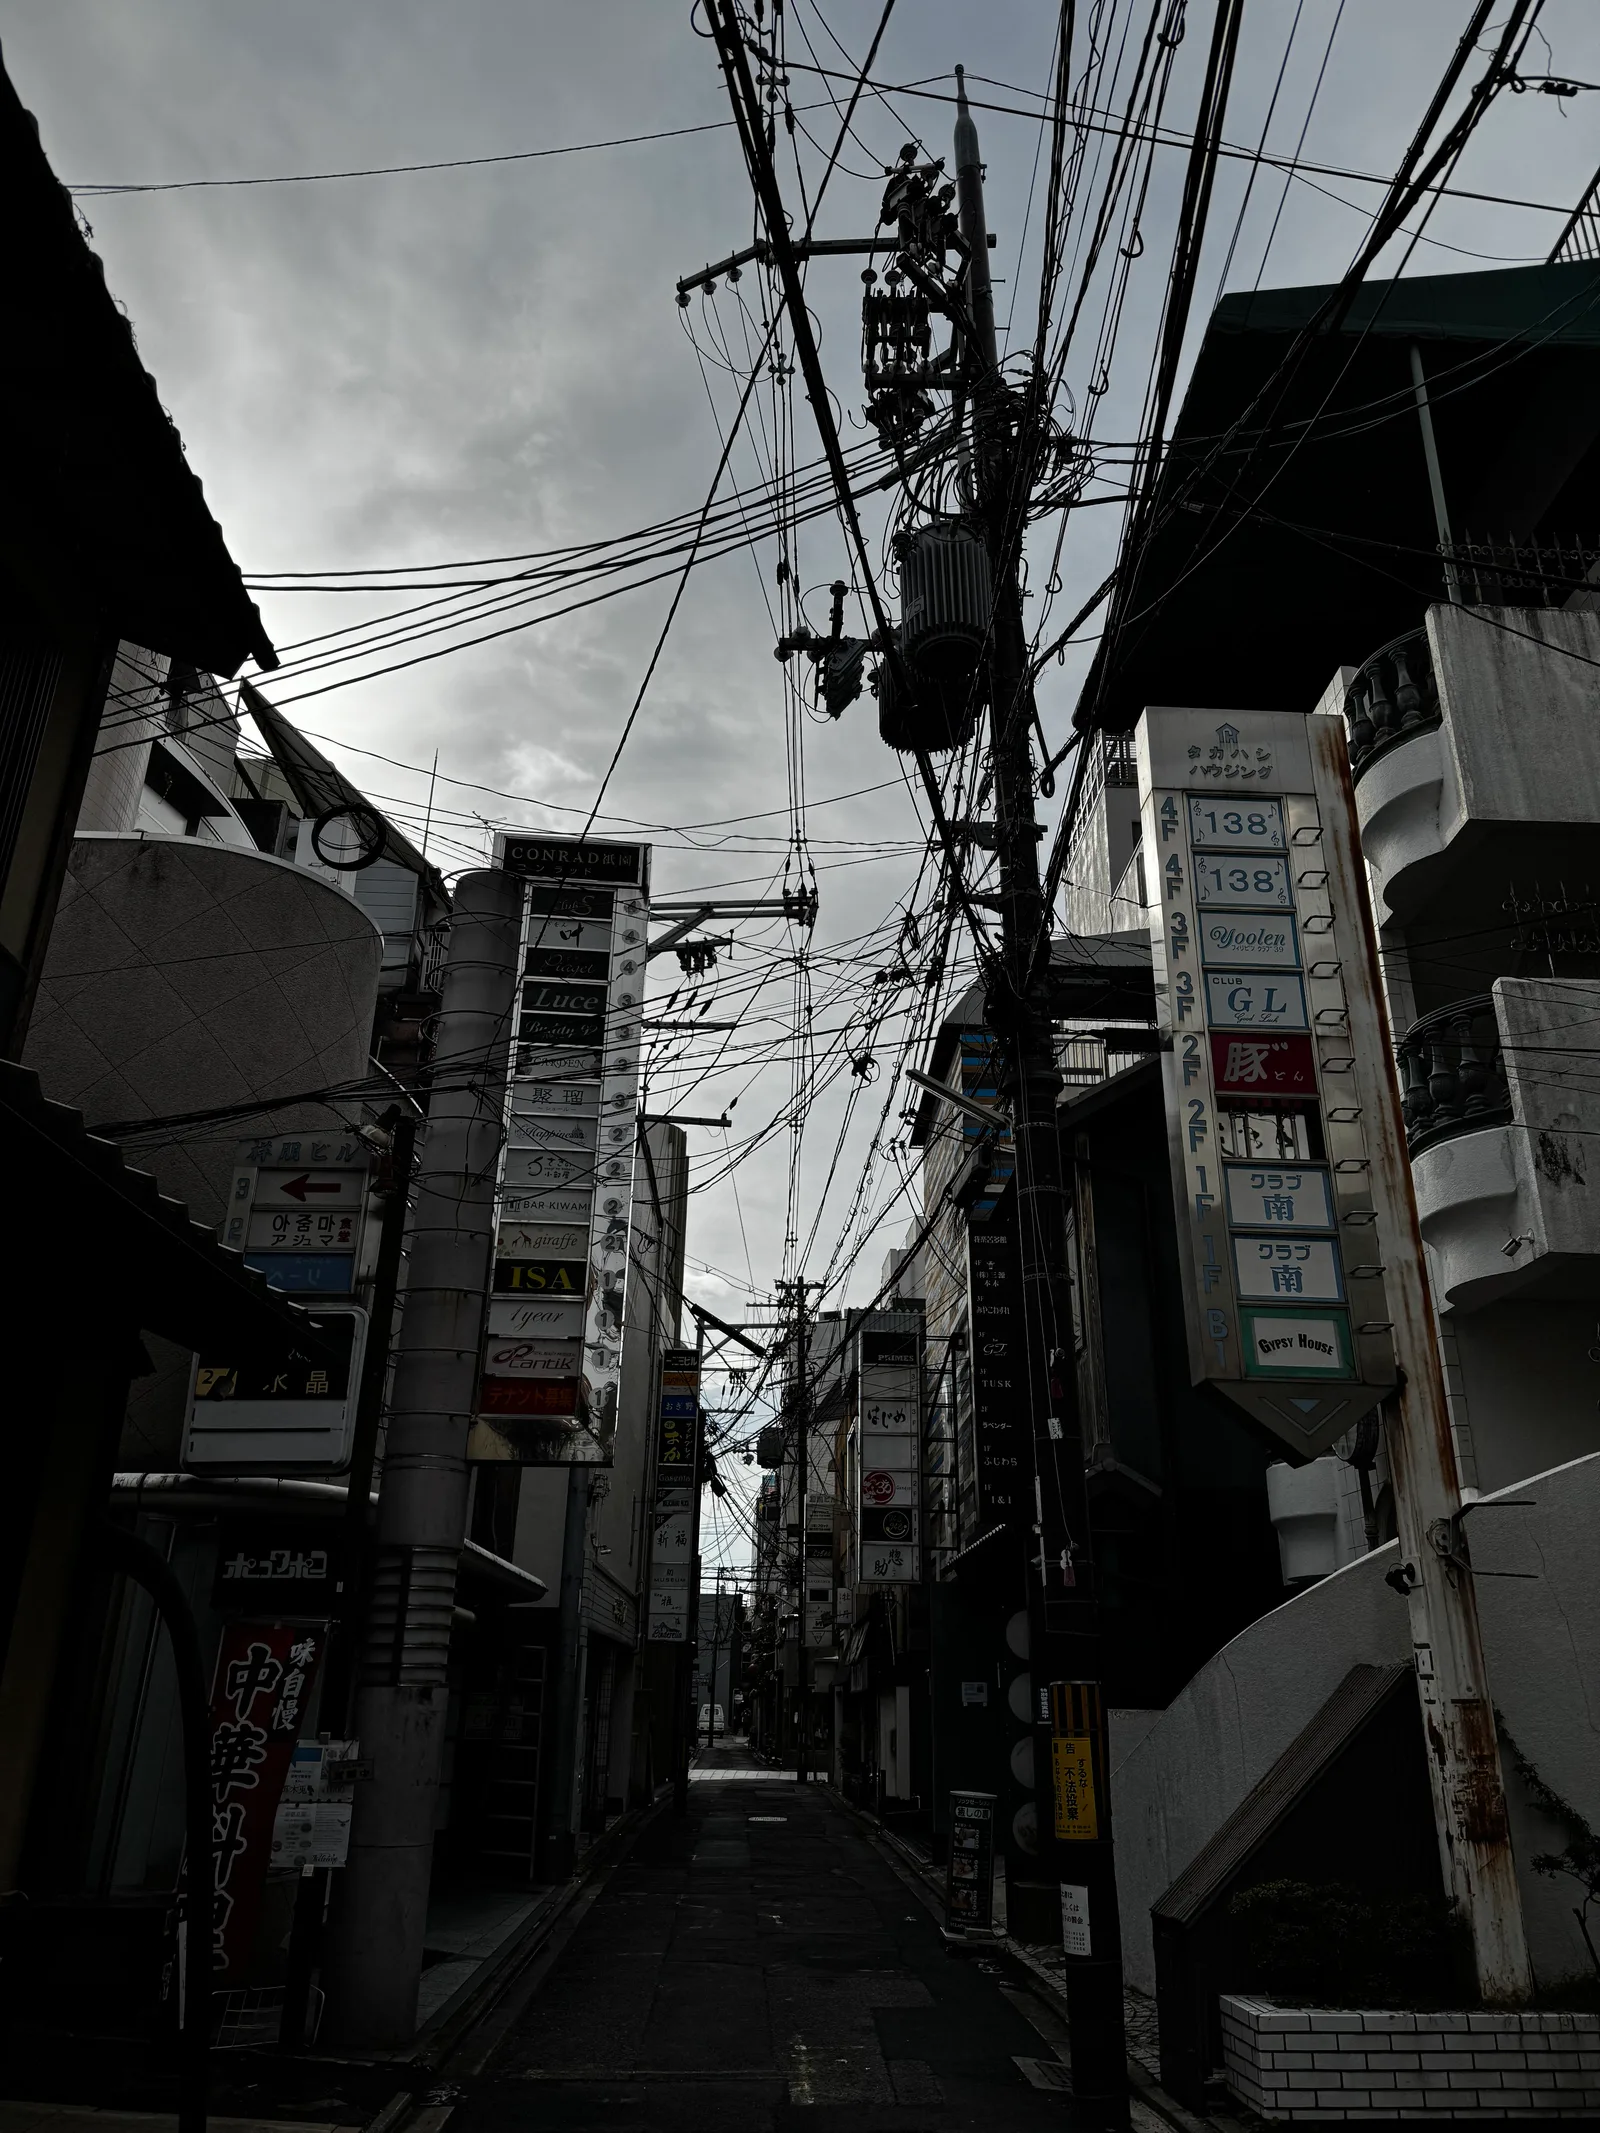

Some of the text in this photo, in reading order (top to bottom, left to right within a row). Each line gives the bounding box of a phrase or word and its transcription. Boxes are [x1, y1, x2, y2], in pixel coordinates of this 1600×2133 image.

[1188, 745, 1271, 761] タカハシ
[1189, 763, 1274, 779] ハウジング
[1160, 796, 1178, 842] 4F
[1204, 811, 1268, 835] 138
[517, 863, 592, 876] コンラッド
[1165, 853, 1183, 900] 4F
[1209, 868, 1274, 893] 138
[1170, 912, 1189, 960] 3F
[1209, 926, 1286, 949] Yoolen
[623, 961, 634, 973] 4
[1212, 976, 1243, 985] CLUB
[532, 988, 599, 1010] Luce
[1176, 971, 1195, 1022] 3F
[1182, 1035, 1201, 1086] 2F
[615, 1094, 625, 1109] 3
[613, 1128, 623, 1142] 2
[1188, 1099, 1208, 1153] 2F
[611, 1162, 621, 1176] 2
[235, 1177, 250, 1200] 3
[1250, 1173, 1302, 1191] クラブ
[523, 1201, 590, 1211] BAR KIWAMI
[608, 1200, 618, 1214] 2
[1262, 1194, 1295, 1222] 南
[272, 1213, 336, 1233] 아줌마
[337, 1217, 352, 1243] 食堂
[532, 1232, 578, 1249] giraffe
[605, 1236, 616, 1250] 2
[1258, 1243, 1311, 1261] クラブ
[508, 1266, 576, 1291] ISA
[603, 1271, 611, 1287] 1
[1270, 1265, 1303, 1294] 南
[515, 1311, 564, 1331] year
[601, 1312, 608, 1327] 1
[597, 1351, 605, 1366] 1
[202, 1370, 214, 1384] 2
[262, 1370, 329, 1394] 水晶
[982, 1380, 1012, 1388] TUSK
[489, 1386, 574, 1409] テナント募集
[595, 1390, 602, 1405] 1
[983, 1457, 1018, 1467] ふじわら
[271, 1638, 315, 1731] 味自慢
[1064, 1766, 1079, 1821] 不法投棄
